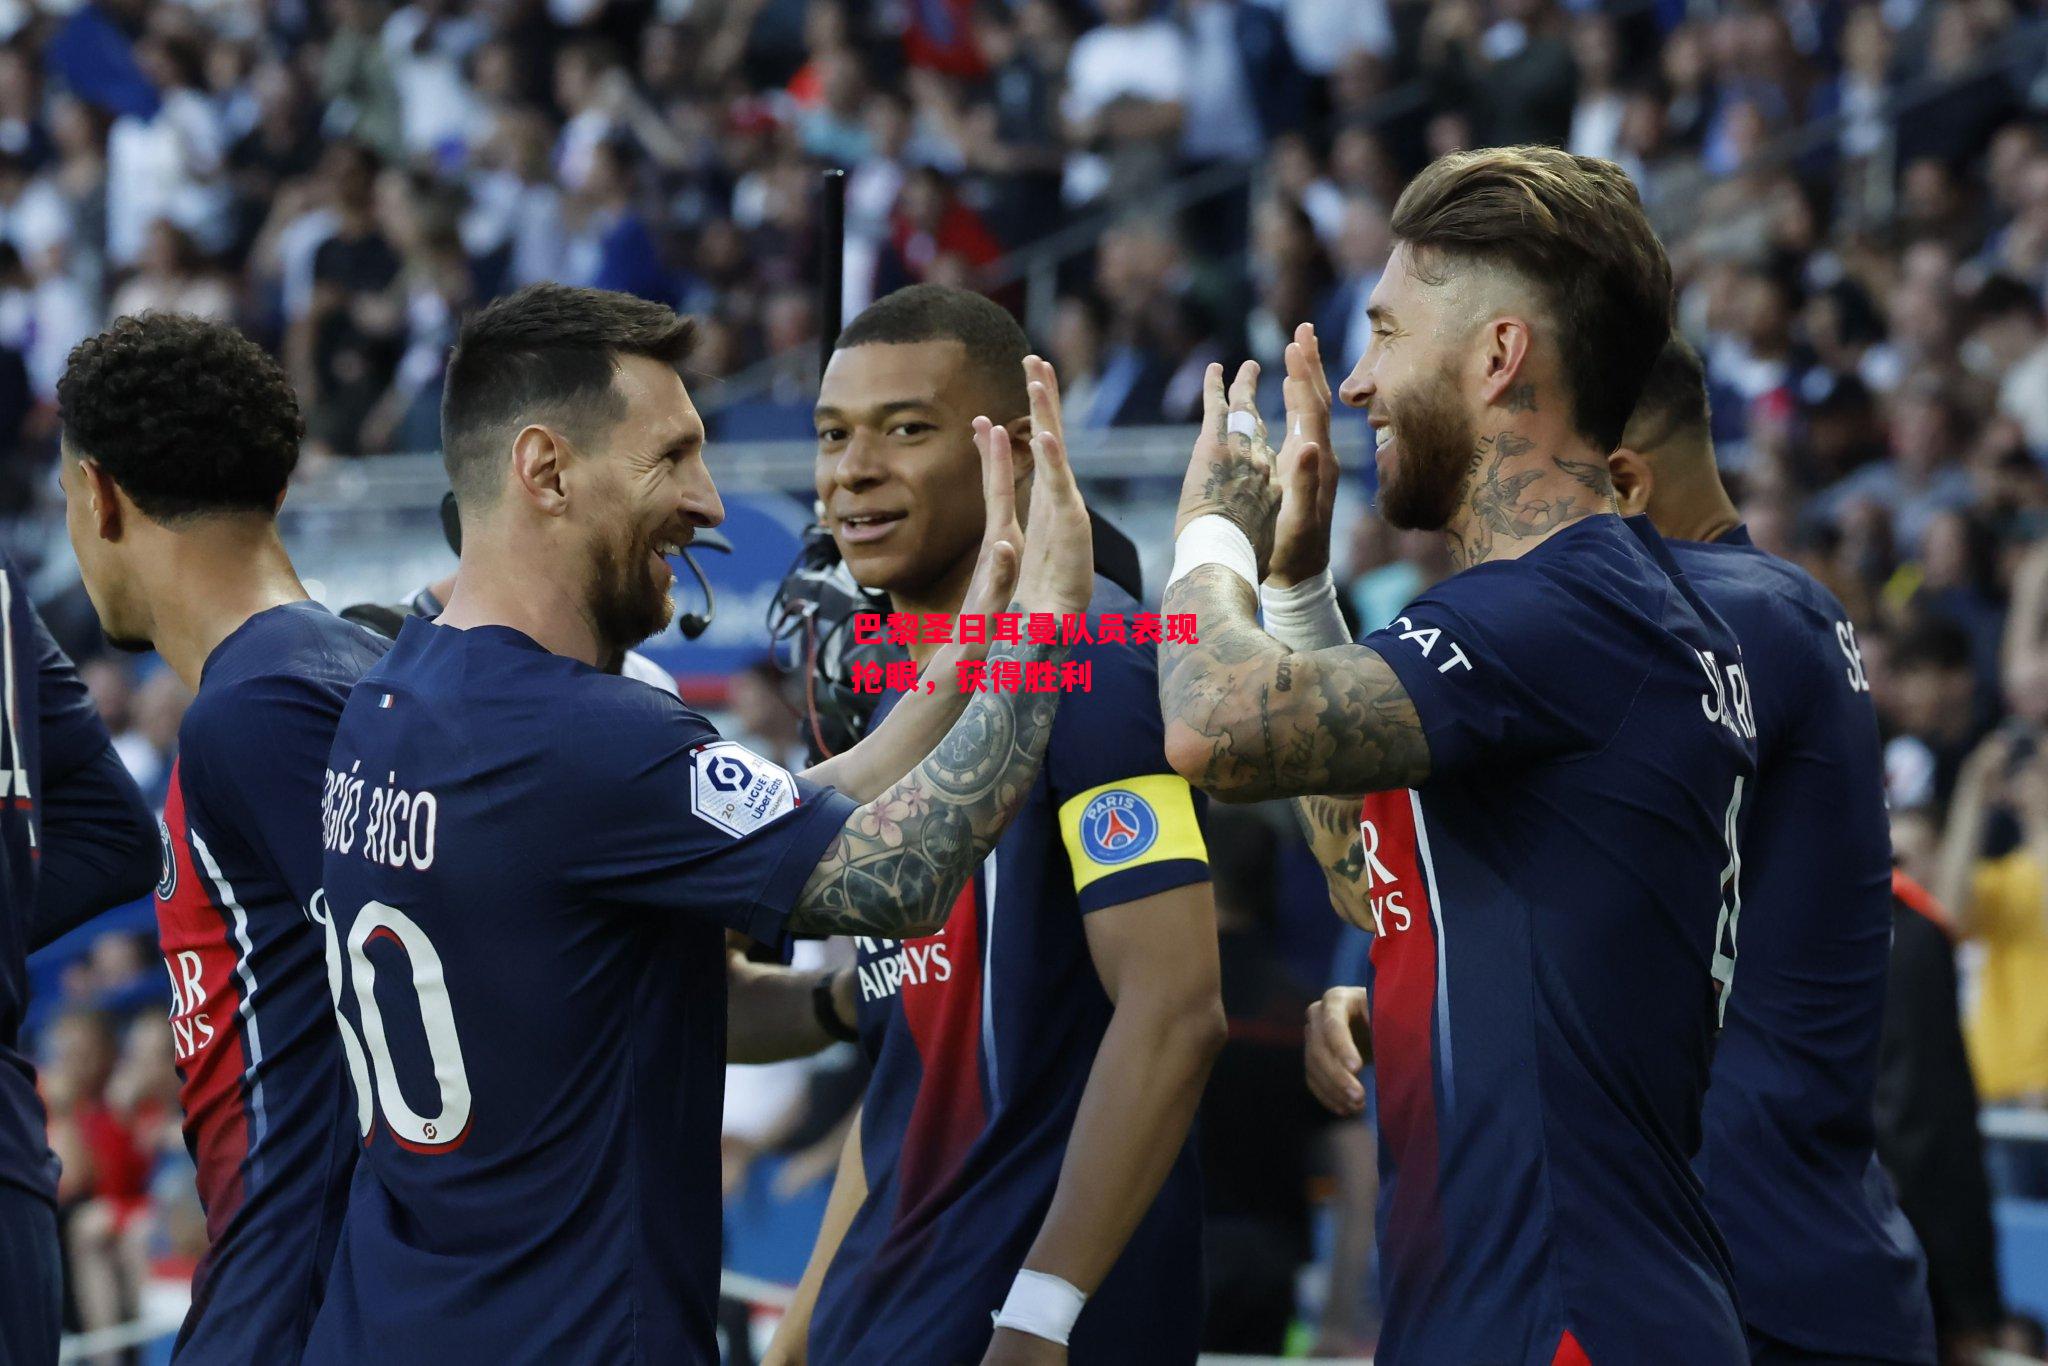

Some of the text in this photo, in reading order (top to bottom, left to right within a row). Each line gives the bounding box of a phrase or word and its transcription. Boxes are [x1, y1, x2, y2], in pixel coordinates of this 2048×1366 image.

[744, 778, 767, 808] LIGUE
[751, 778, 783, 819] Uber Eats
[1087, 795, 1135, 820] PARIS
[857, 942, 952, 1003] AIRAYS
